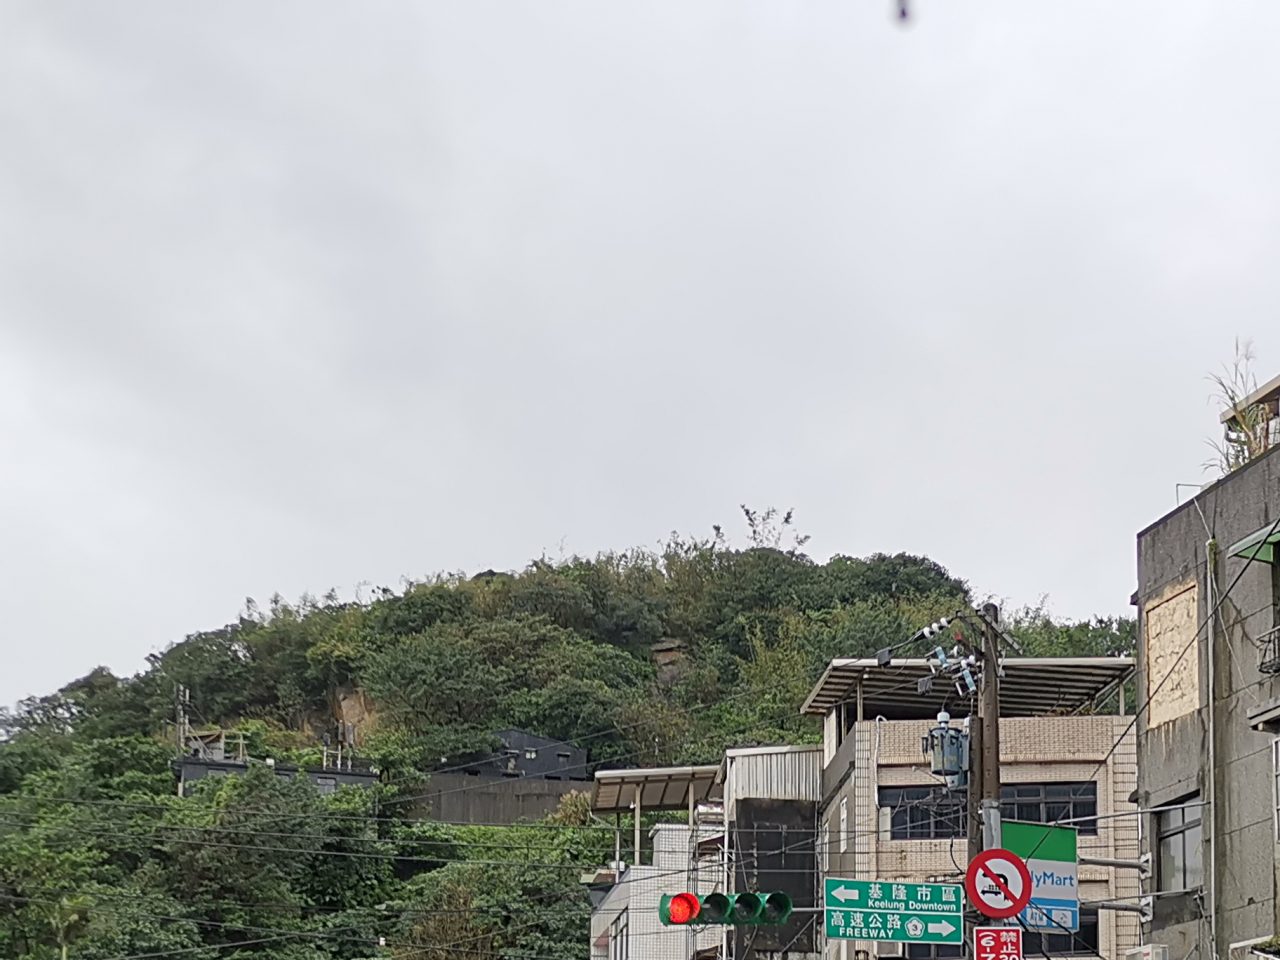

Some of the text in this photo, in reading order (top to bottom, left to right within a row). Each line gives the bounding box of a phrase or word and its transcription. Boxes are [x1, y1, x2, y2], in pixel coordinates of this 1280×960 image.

[868, 884, 956, 901] 基隆市區
[868, 900, 956, 911] Keelung Downtown
[831, 912, 901, 929] 高速公路
[839, 927, 894, 938] FREEWAY
